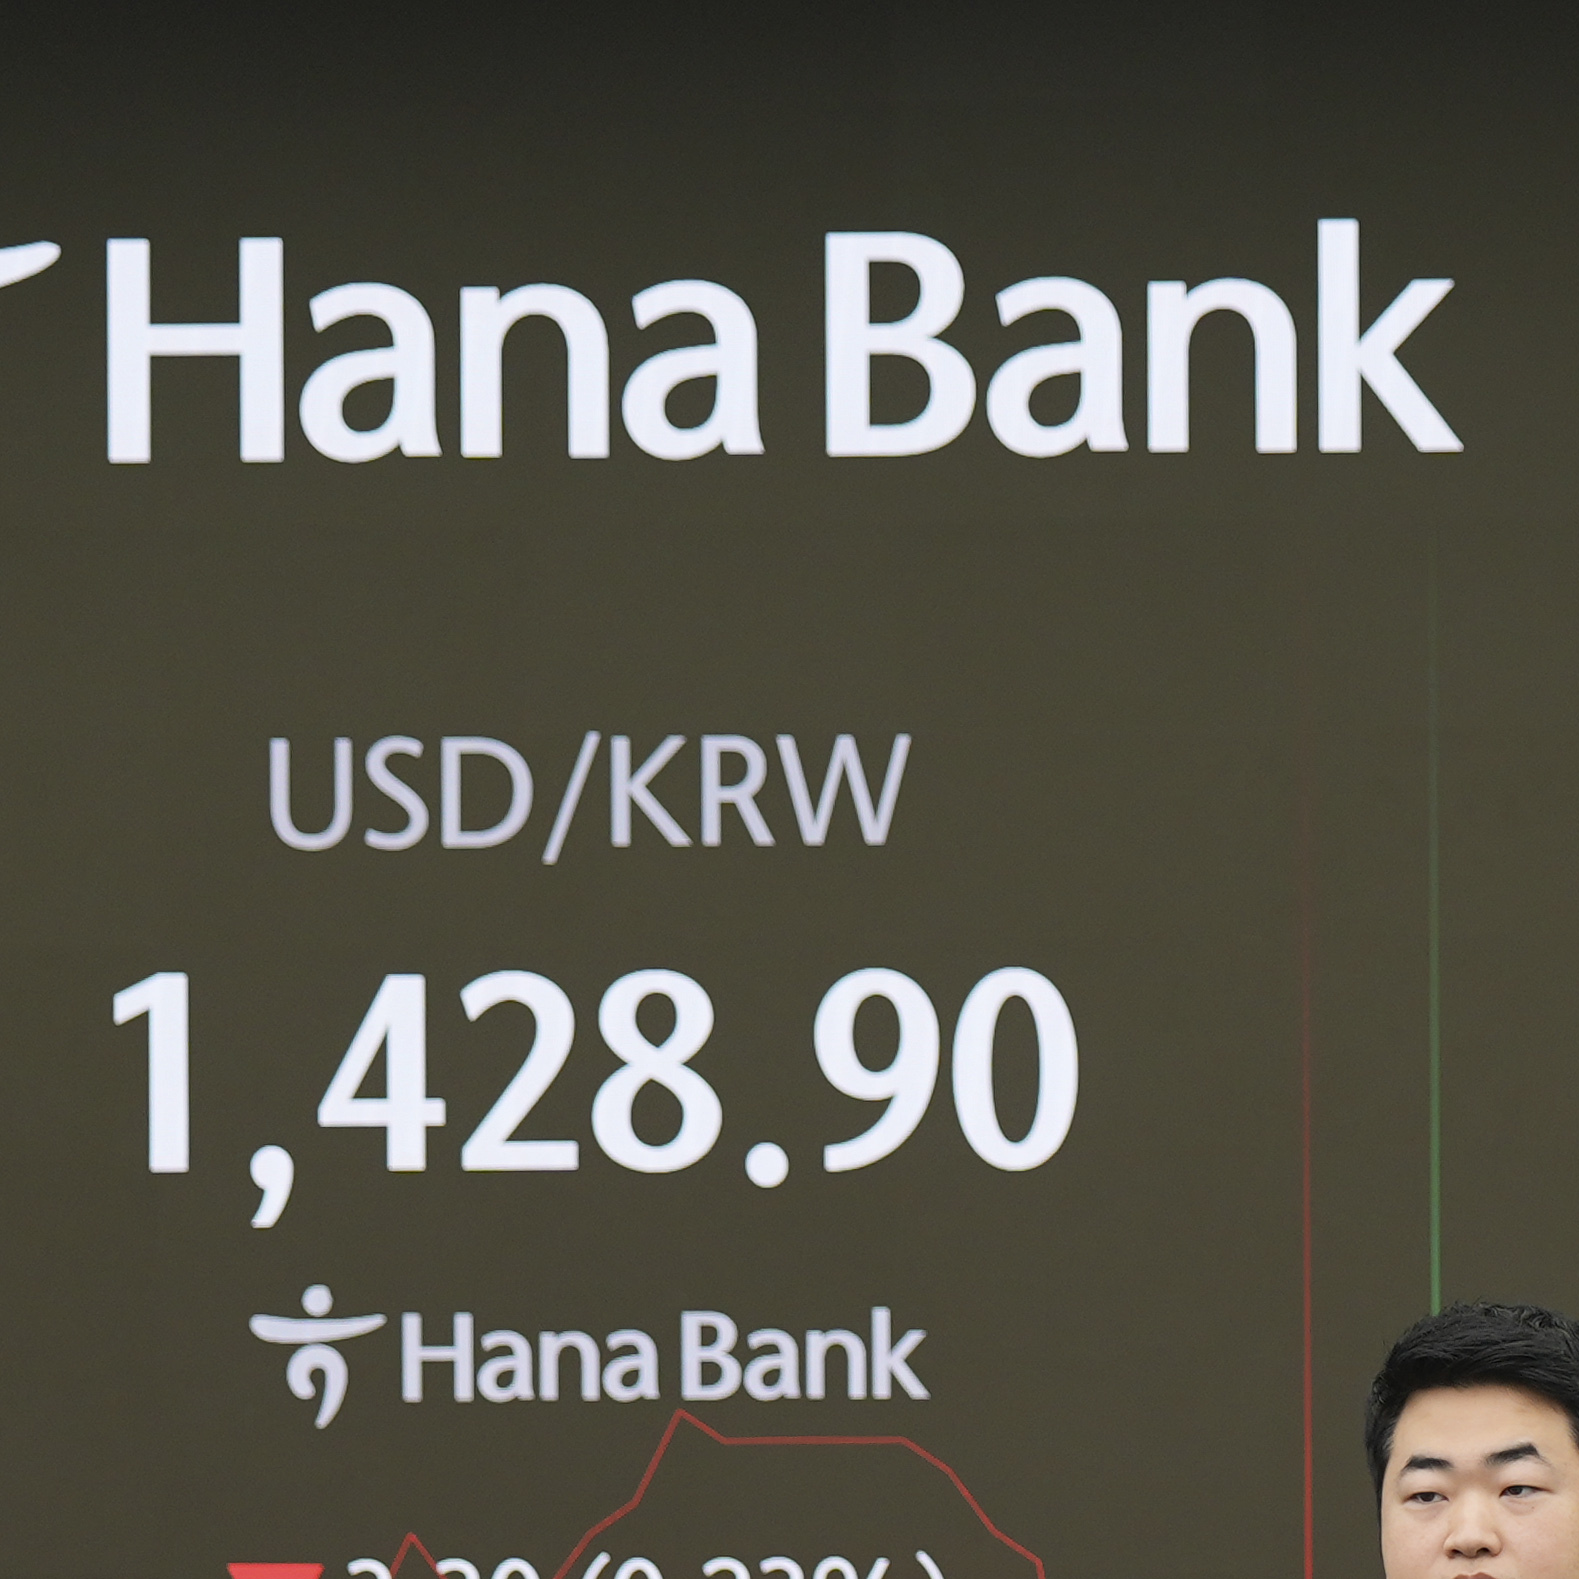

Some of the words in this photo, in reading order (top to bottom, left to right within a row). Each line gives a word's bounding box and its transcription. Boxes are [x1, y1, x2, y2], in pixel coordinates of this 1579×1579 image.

[106, 236, 766, 465] Hana
[824, 218, 1465, 459] Bank
[268, 729, 913, 866] USD/KRW
[112, 966, 1080, 1229] 1,428.90
[401, 1311, 661, 1404] Hana
[680, 1305, 930, 1402] Bank
